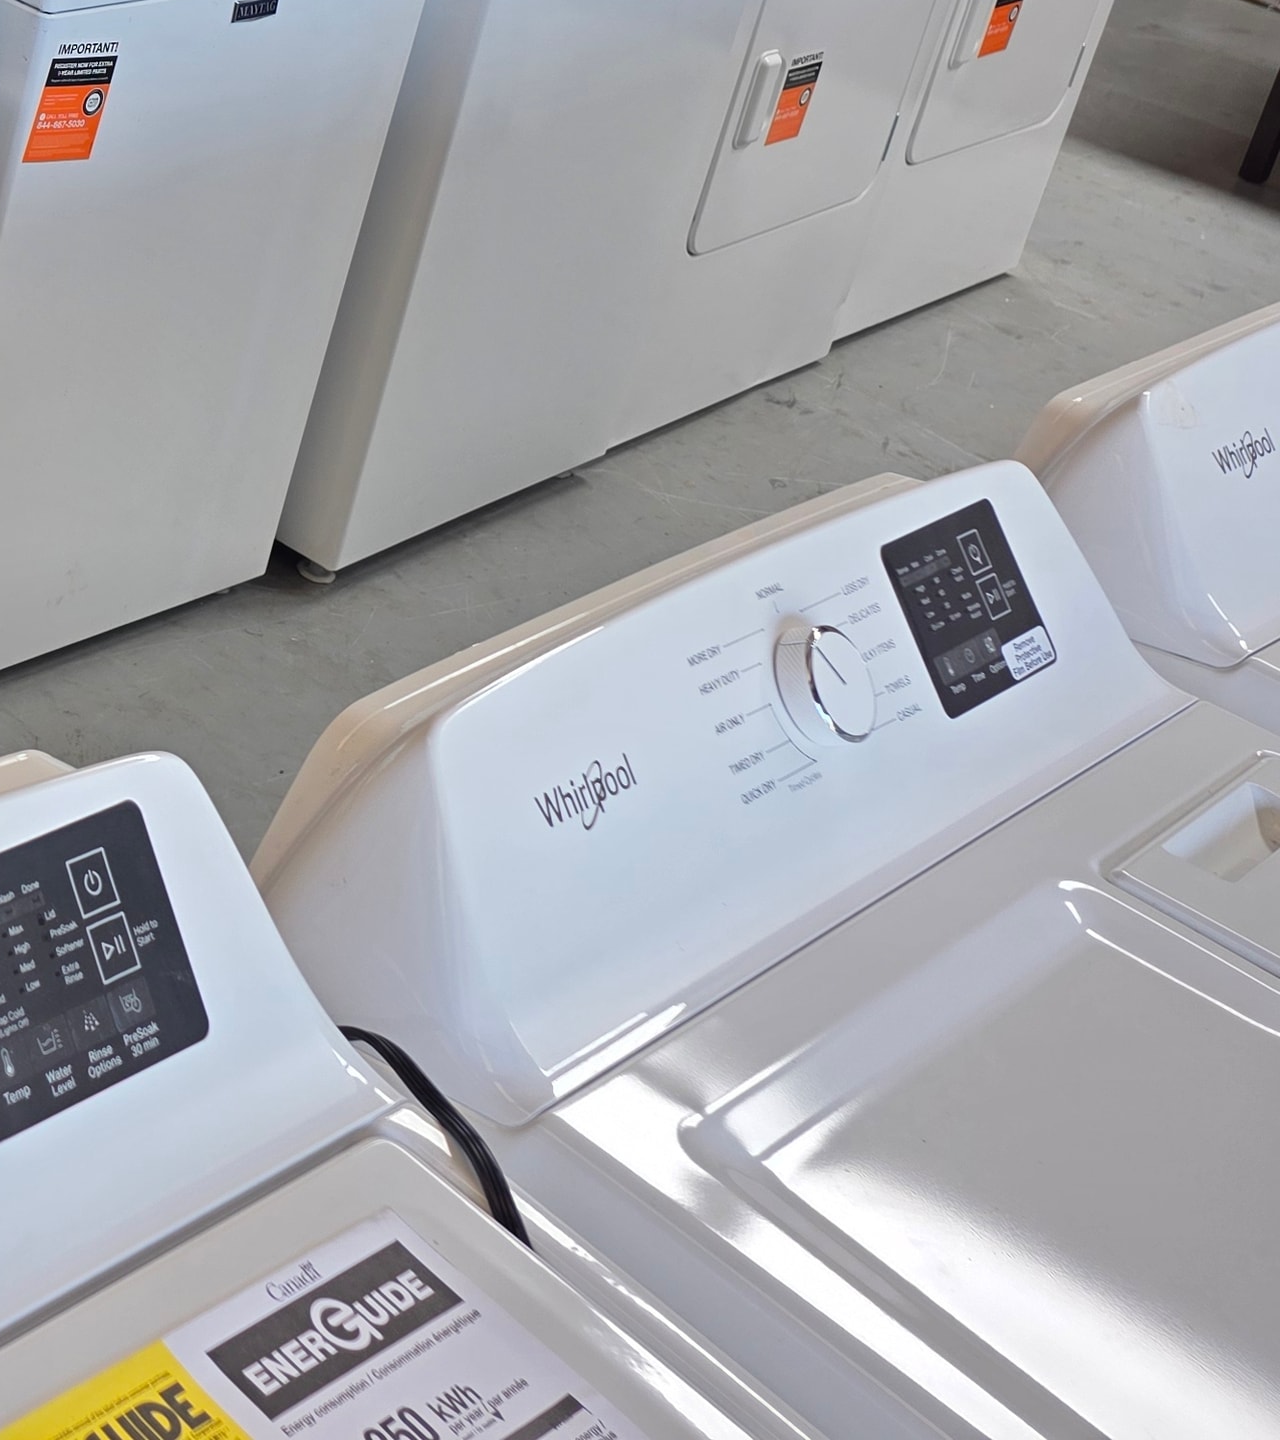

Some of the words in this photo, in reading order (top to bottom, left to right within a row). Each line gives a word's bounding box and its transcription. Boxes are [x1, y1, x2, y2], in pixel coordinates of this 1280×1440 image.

[238, 0, 277, 16] MAYTAG
[58, 42, 119, 55] IMPORTANT!
[791, 51, 824, 67] IMPORTANT!
[1211, 427, 1275, 479] Whirlpool
[1013, 635, 1035, 650] Remove
[1013, 665, 1024, 676] Film
[1022, 656, 1042, 672] Before
[1041, 650, 1053, 662] Use
[1015, 645, 1042, 664] Protective
[534, 752, 637, 830] Whirlpool
[21, 879, 40, 895] Done
[43, 909, 56, 921] Lid
[8, 923, 24, 936] Max
[49, 920, 78, 940] PreSoak
[133, 922, 151, 937] Hold
[150, 918, 158, 930] to
[14, 941, 32, 956] High
[55, 937, 84, 957] Softener
[136, 931, 156, 947] Start
[19, 959, 36, 975] Med
[60, 961, 80, 976] Extra
[24, 978, 42, 992] Low
[64, 970, 84, 985] Rinse
[6, 1006, 25, 1021] Cold
[123, 1021, 160, 1046] PreSoak
[88, 1043, 114, 1064] Rinse
[131, 1042, 145, 1057] 30
[142, 1035, 160, 1052] min
[45, 1063, 74, 1084] Water
[87, 1053, 122, 1080] Options
[3, 1084, 32, 1106] Temp
[51, 1076, 77, 1098] Level
[241, 1268, 435, 1396] ENERGUIDE
[280, 1412, 318, 1438] Energy
[314, 1378, 370, 1419] consumption
[373, 1335, 434, 1379] Consommation
[433, 1307, 482, 1344] énergétique
[426, 1384, 483, 1421] kWh
[448, 1415, 467, 1437] per
[463, 1403, 484, 1424] year
[502, 1377, 530, 1402] année
